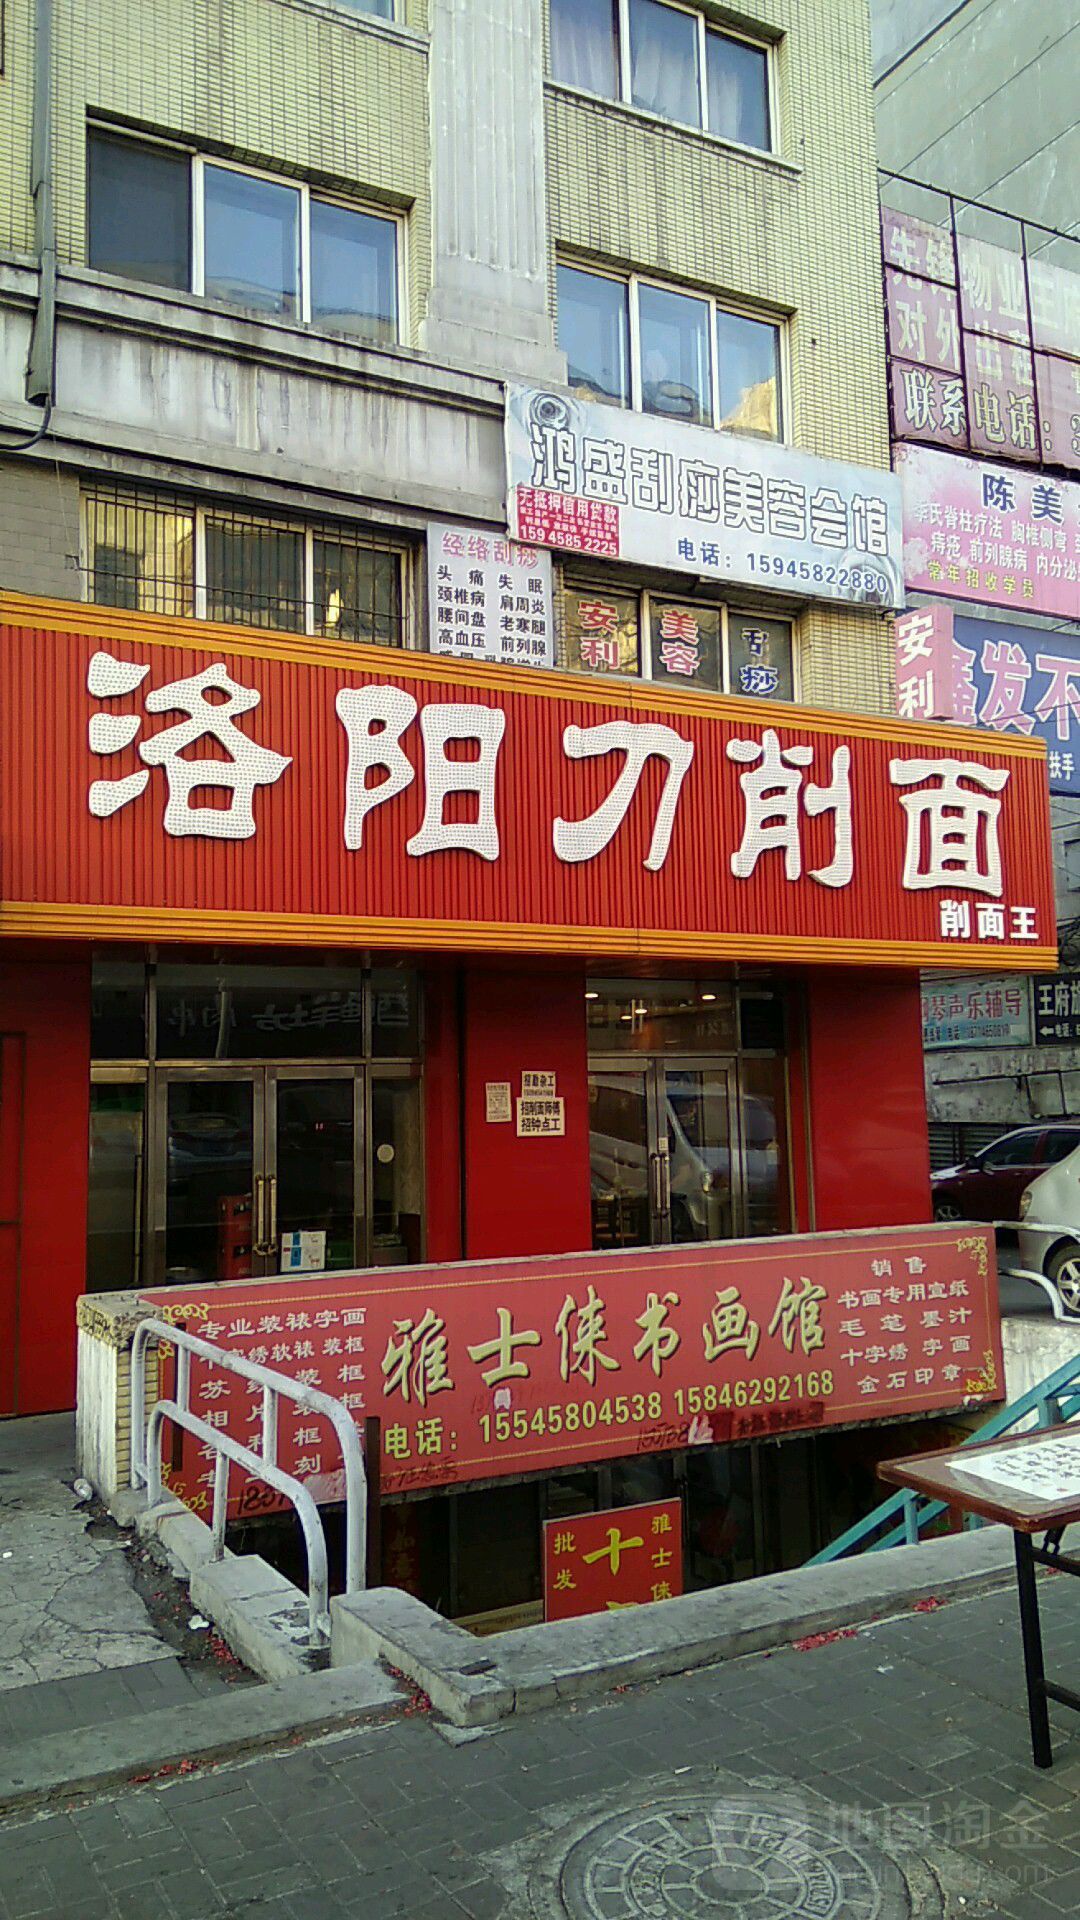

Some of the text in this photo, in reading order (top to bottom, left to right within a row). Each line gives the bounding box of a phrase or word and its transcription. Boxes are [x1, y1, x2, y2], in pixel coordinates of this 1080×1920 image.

[519, 487, 617, 524] 无抵押信用贷款
[530, 423, 889, 557] 鸿盛刮痧美容会馆
[520, 525, 546, 541] 159
[548, 531, 581, 548] 4585
[584, 537, 617, 555] 2225
[498, 573, 544, 595] 失眠
[928, 560, 1034, 599] 常年招收学员
[1036, 552, 1080, 582] 内分泌
[437, 585, 545, 616] 颈椎病 肩周炎
[437, 606, 486, 628] 腰间盘
[438, 628, 546, 657] 高血压 前列腺
[578, 599, 621, 670] 安利
[659, 609, 700, 676] 美容
[897, 612, 935, 719] 安利
[87, 651, 1010, 897] 洛阳刀削面
[939, 899, 1040, 940] 削面王
[837, 1279, 969, 1309] 书画专用宣纸
[197, 1307, 367, 1340] 专业装裱字画
[675, 1369, 833, 1416] 15846292168
[857, 1363, 962, 1394] 金石印章
[553, 1531, 577, 1590] 批发
